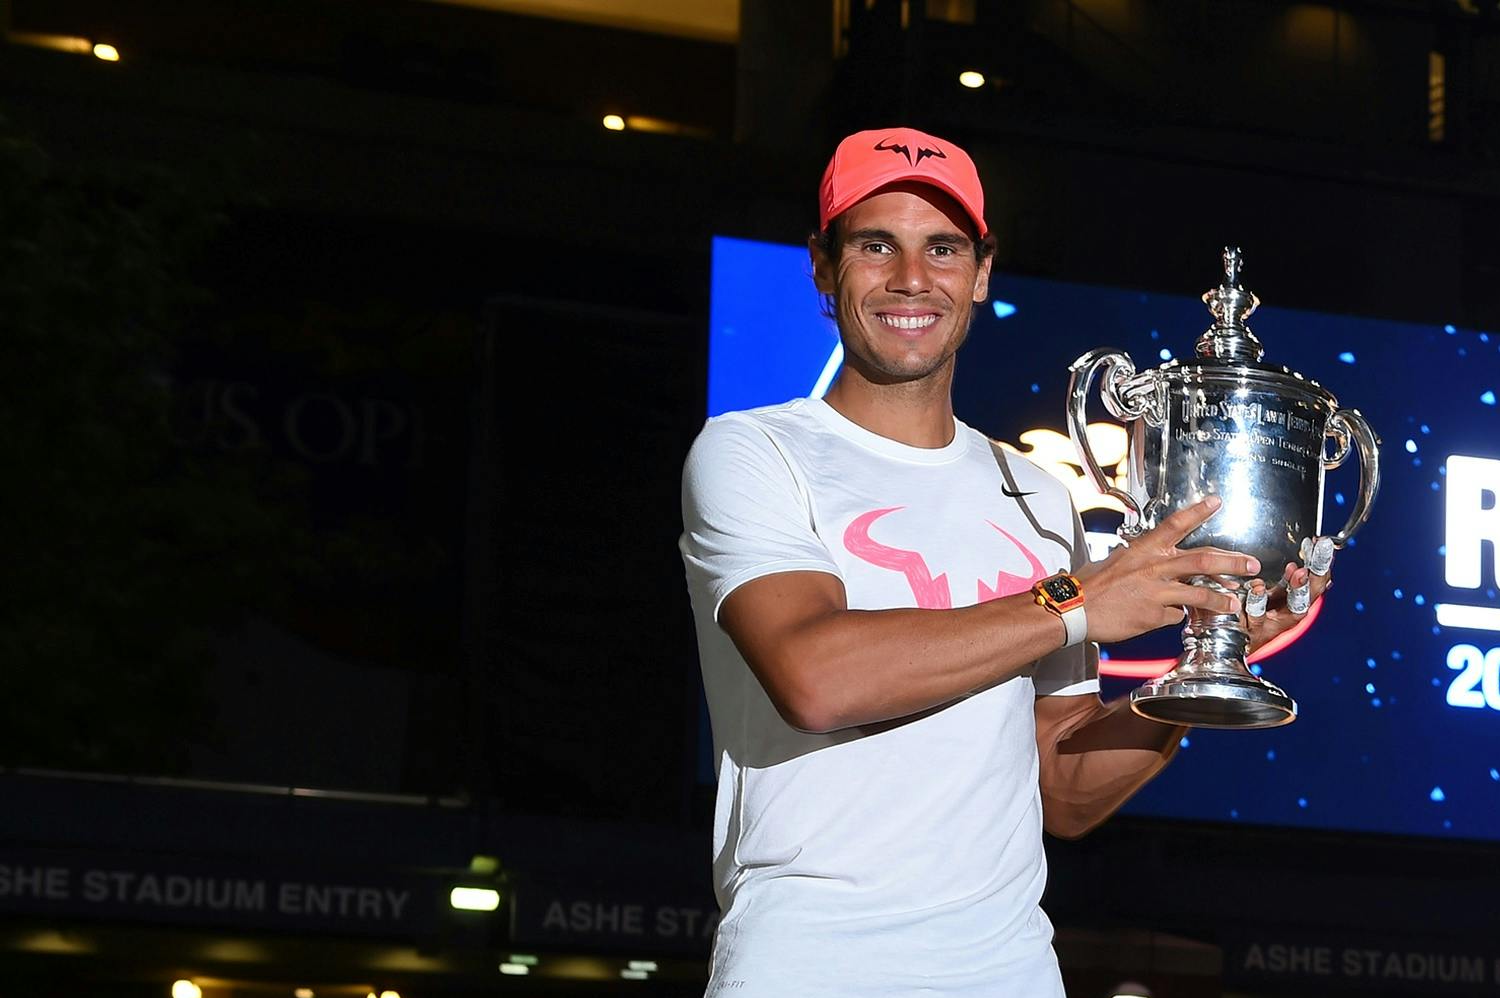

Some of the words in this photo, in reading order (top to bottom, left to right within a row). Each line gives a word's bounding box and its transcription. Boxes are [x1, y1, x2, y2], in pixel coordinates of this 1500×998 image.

[82, 870, 266, 911] STADIUM
[277, 881, 412, 919] ENTRY
[541, 900, 645, 935] ASHE
[1243, 943, 1333, 975] ASHE
[1341, 948, 1485, 984] STADIUM
